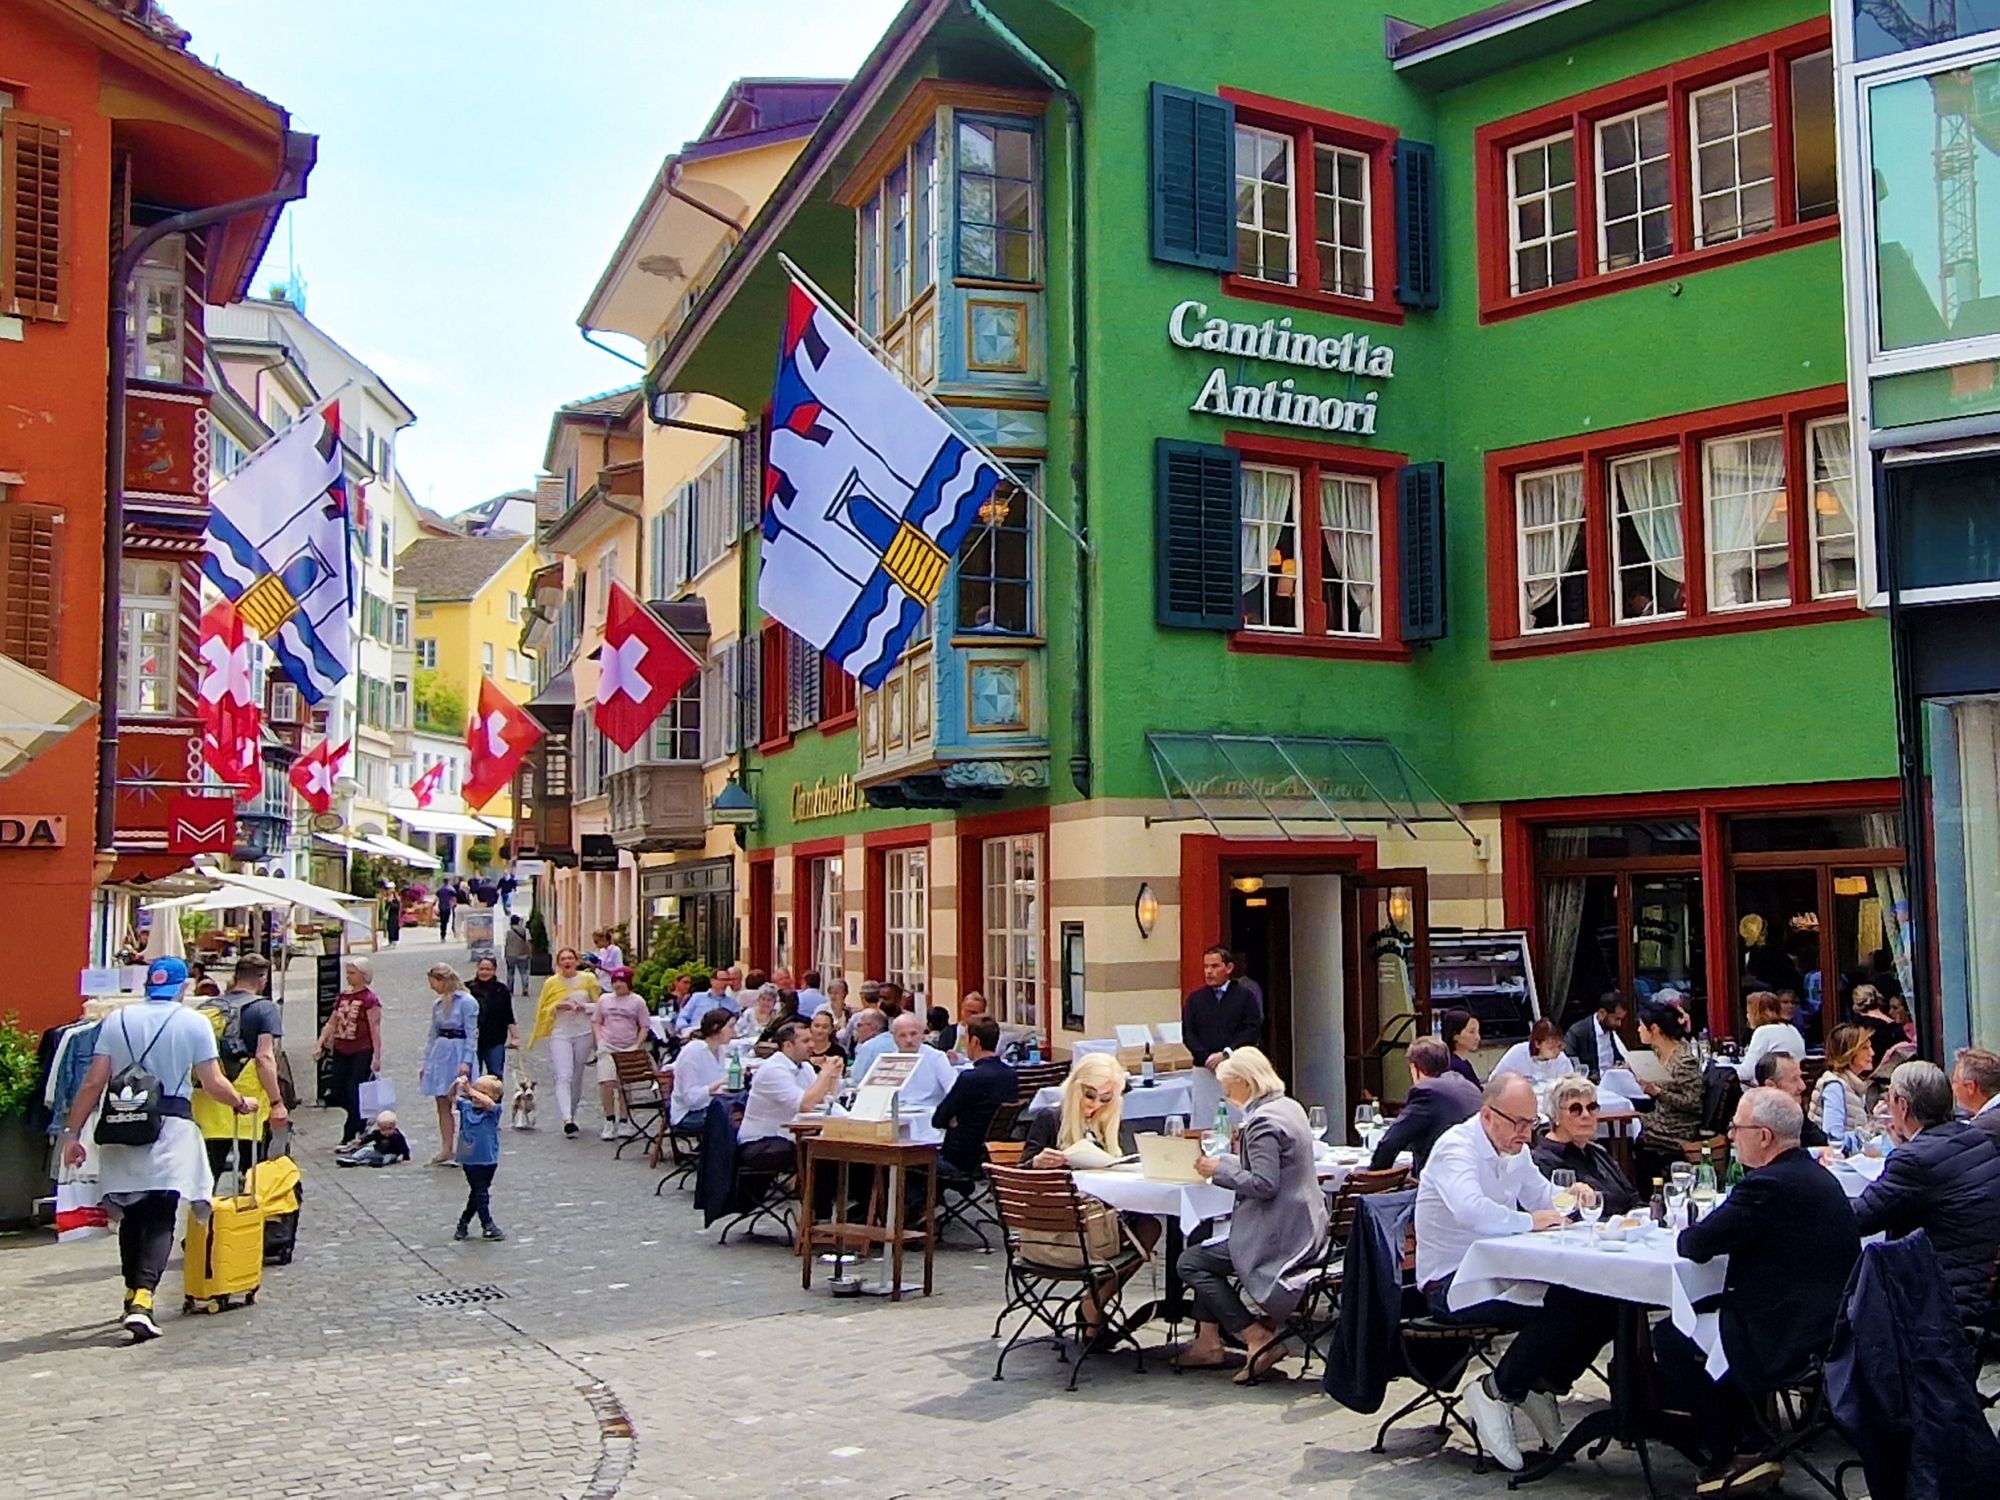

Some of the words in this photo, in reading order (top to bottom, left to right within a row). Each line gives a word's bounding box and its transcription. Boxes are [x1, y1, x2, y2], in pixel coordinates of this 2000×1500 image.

[1168, 300, 1394, 378] Cantinetta
[1190, 367, 1379, 435] Antinori
[105, 1112, 149, 1124] adidas
